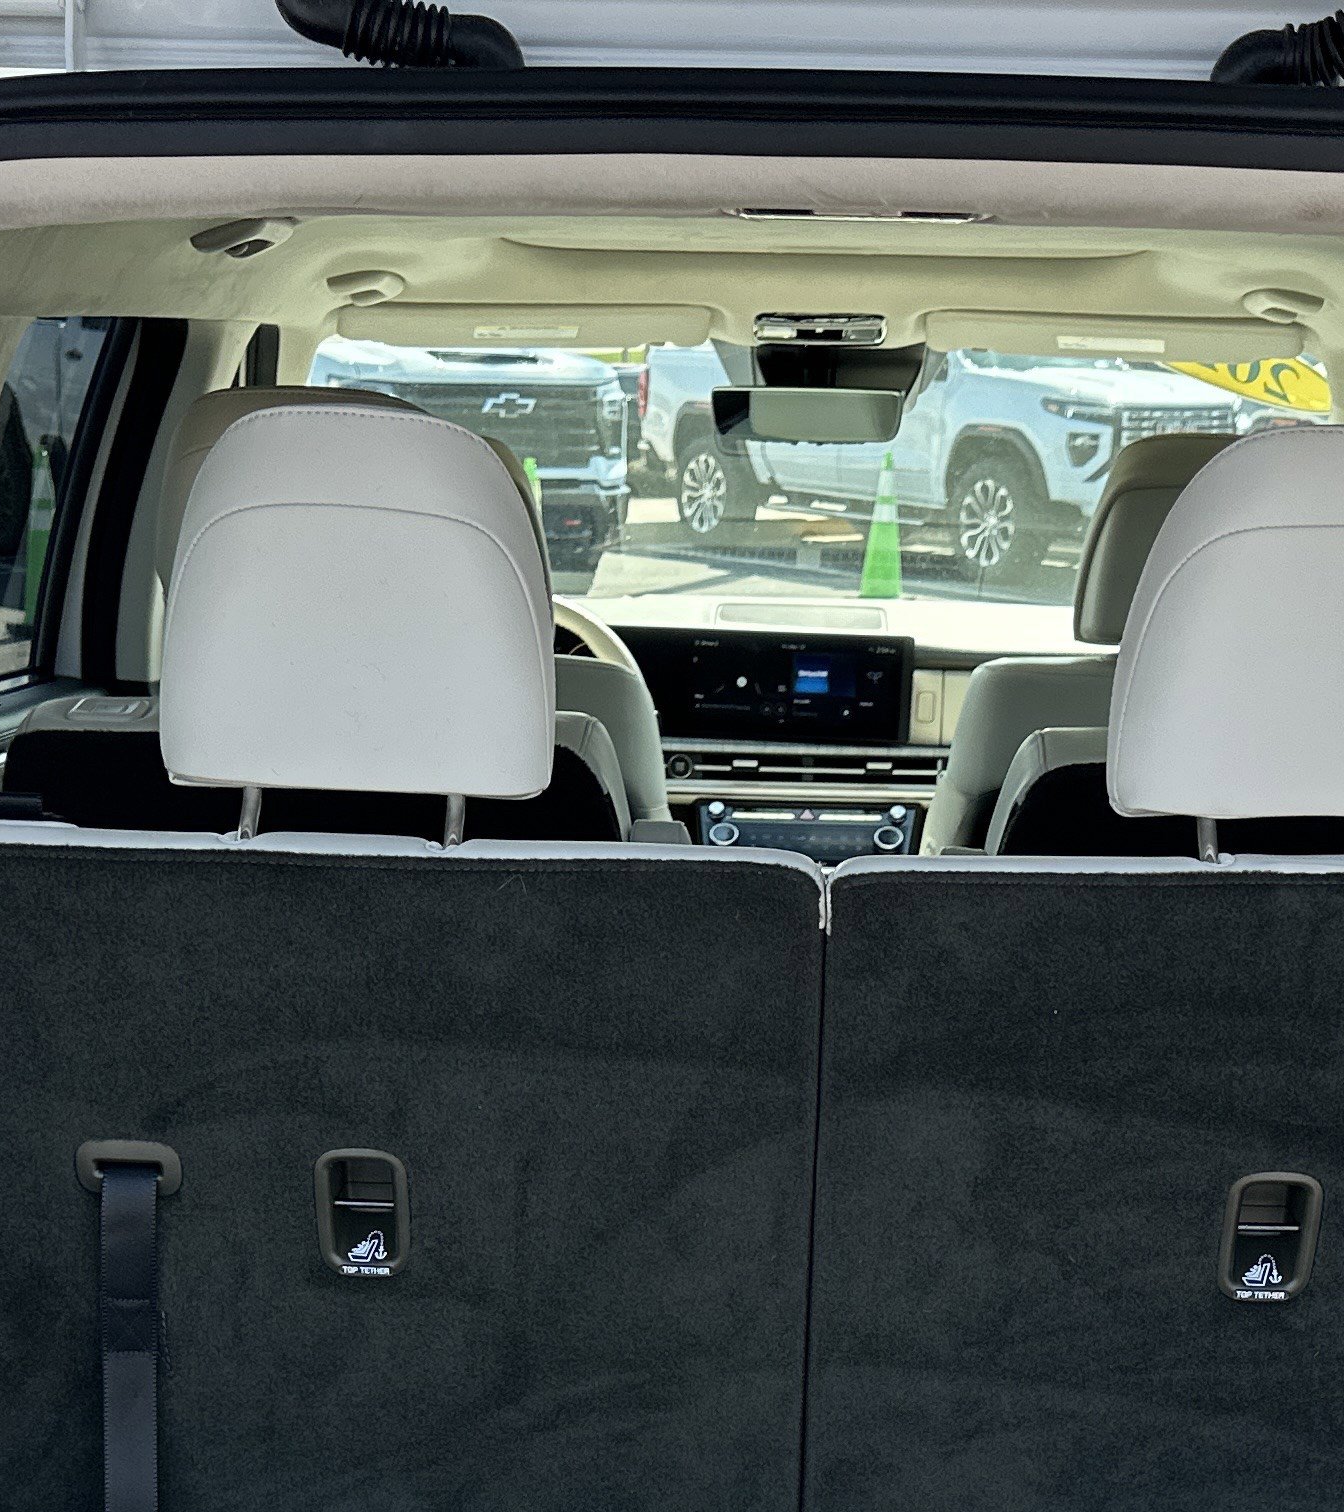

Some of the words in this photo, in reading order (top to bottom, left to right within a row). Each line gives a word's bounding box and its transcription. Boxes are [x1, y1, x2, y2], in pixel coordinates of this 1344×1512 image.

[341, 1265, 359, 1274] TOP
[359, 1266, 390, 1275] TETHER
[1235, 1290, 1253, 1299] TOP
[1253, 1291, 1286, 1300] TETHER
